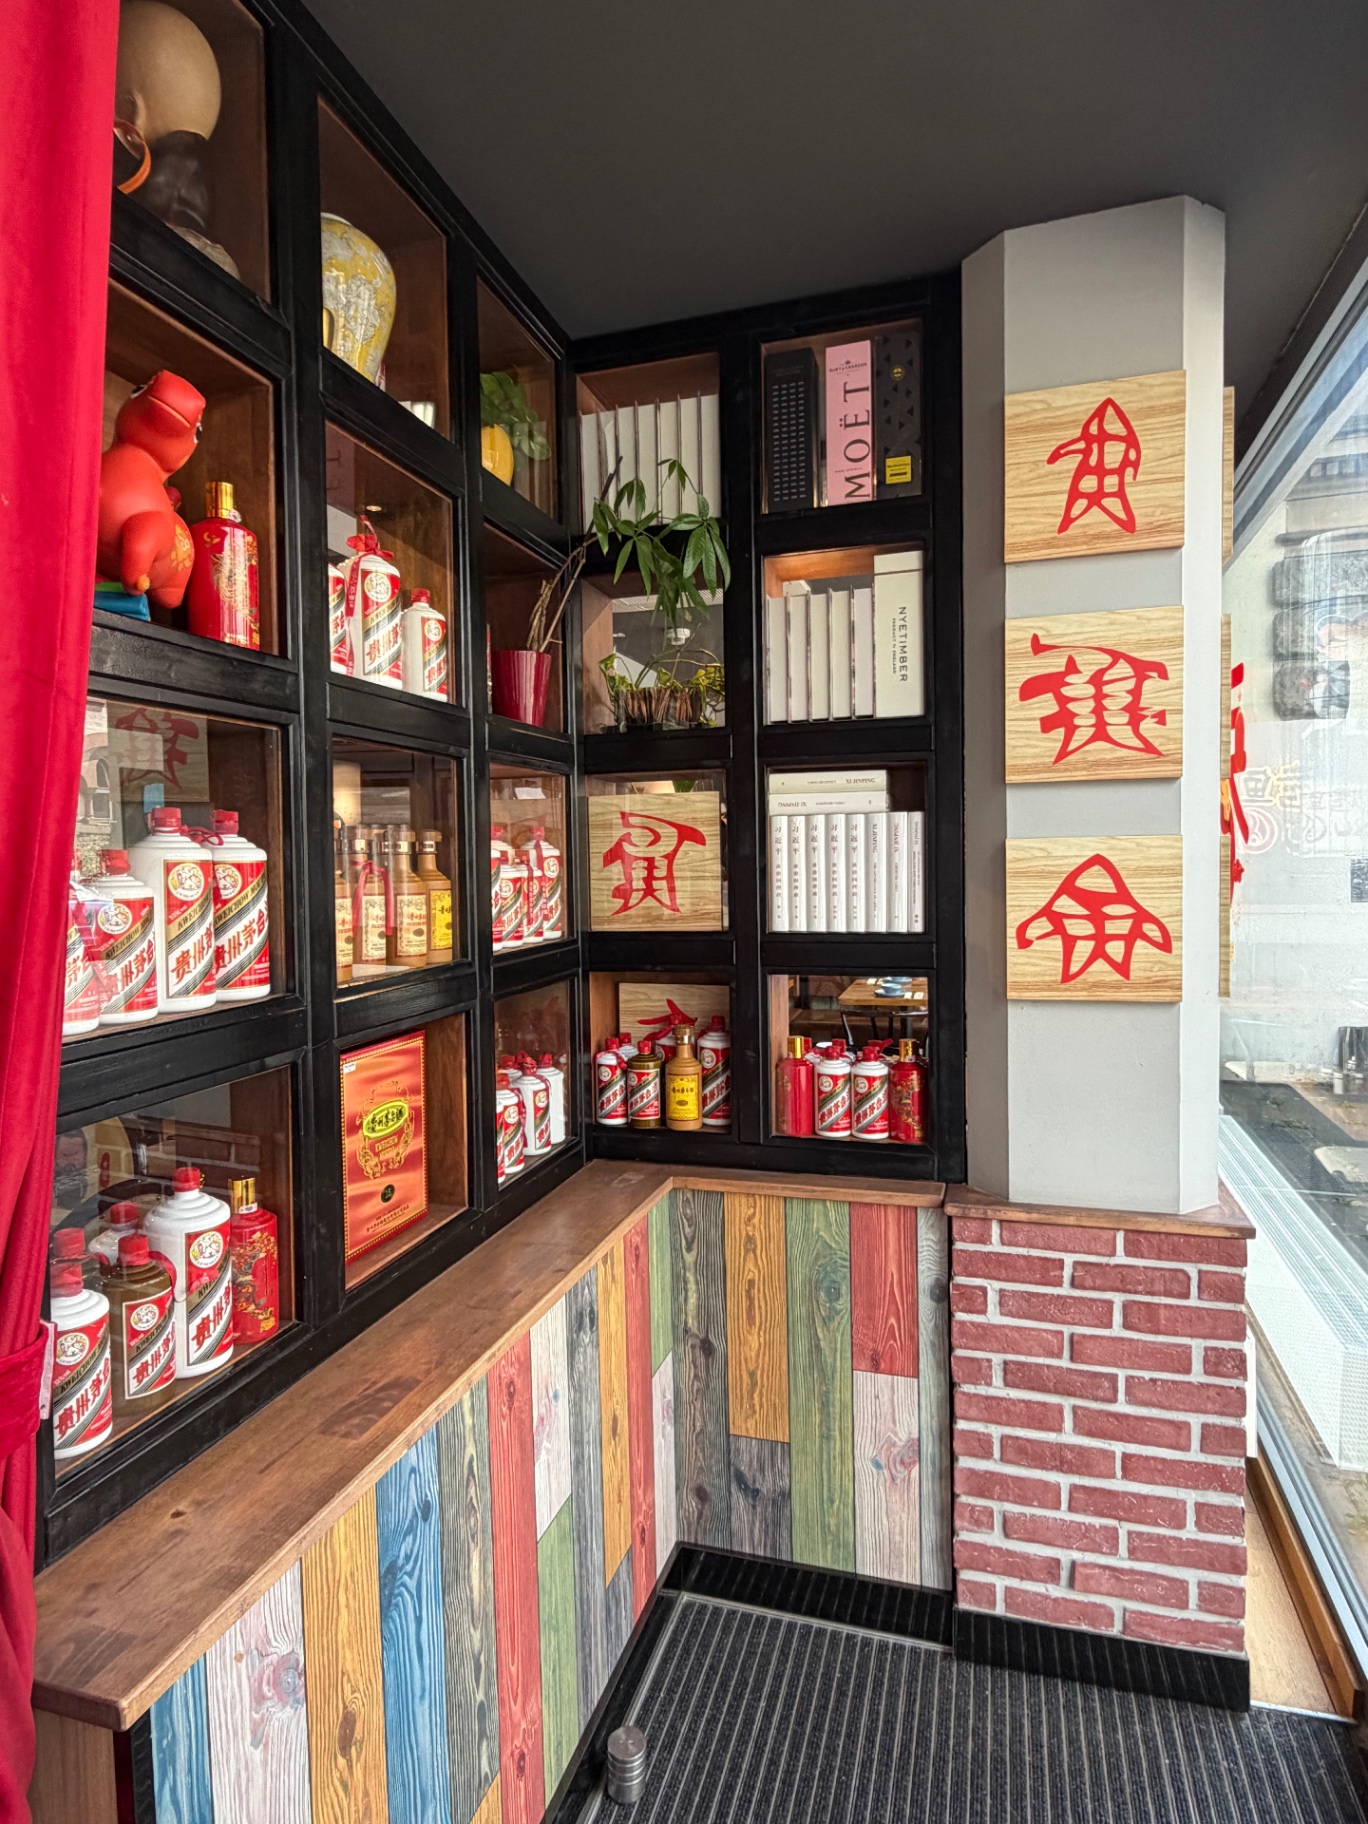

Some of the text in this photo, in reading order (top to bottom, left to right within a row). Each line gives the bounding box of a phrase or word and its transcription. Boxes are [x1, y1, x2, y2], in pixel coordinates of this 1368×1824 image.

[839, 381, 871, 499] MOËT
[898, 606, 909, 683] NYETIMBER
[853, 777, 876, 785] JINPING
